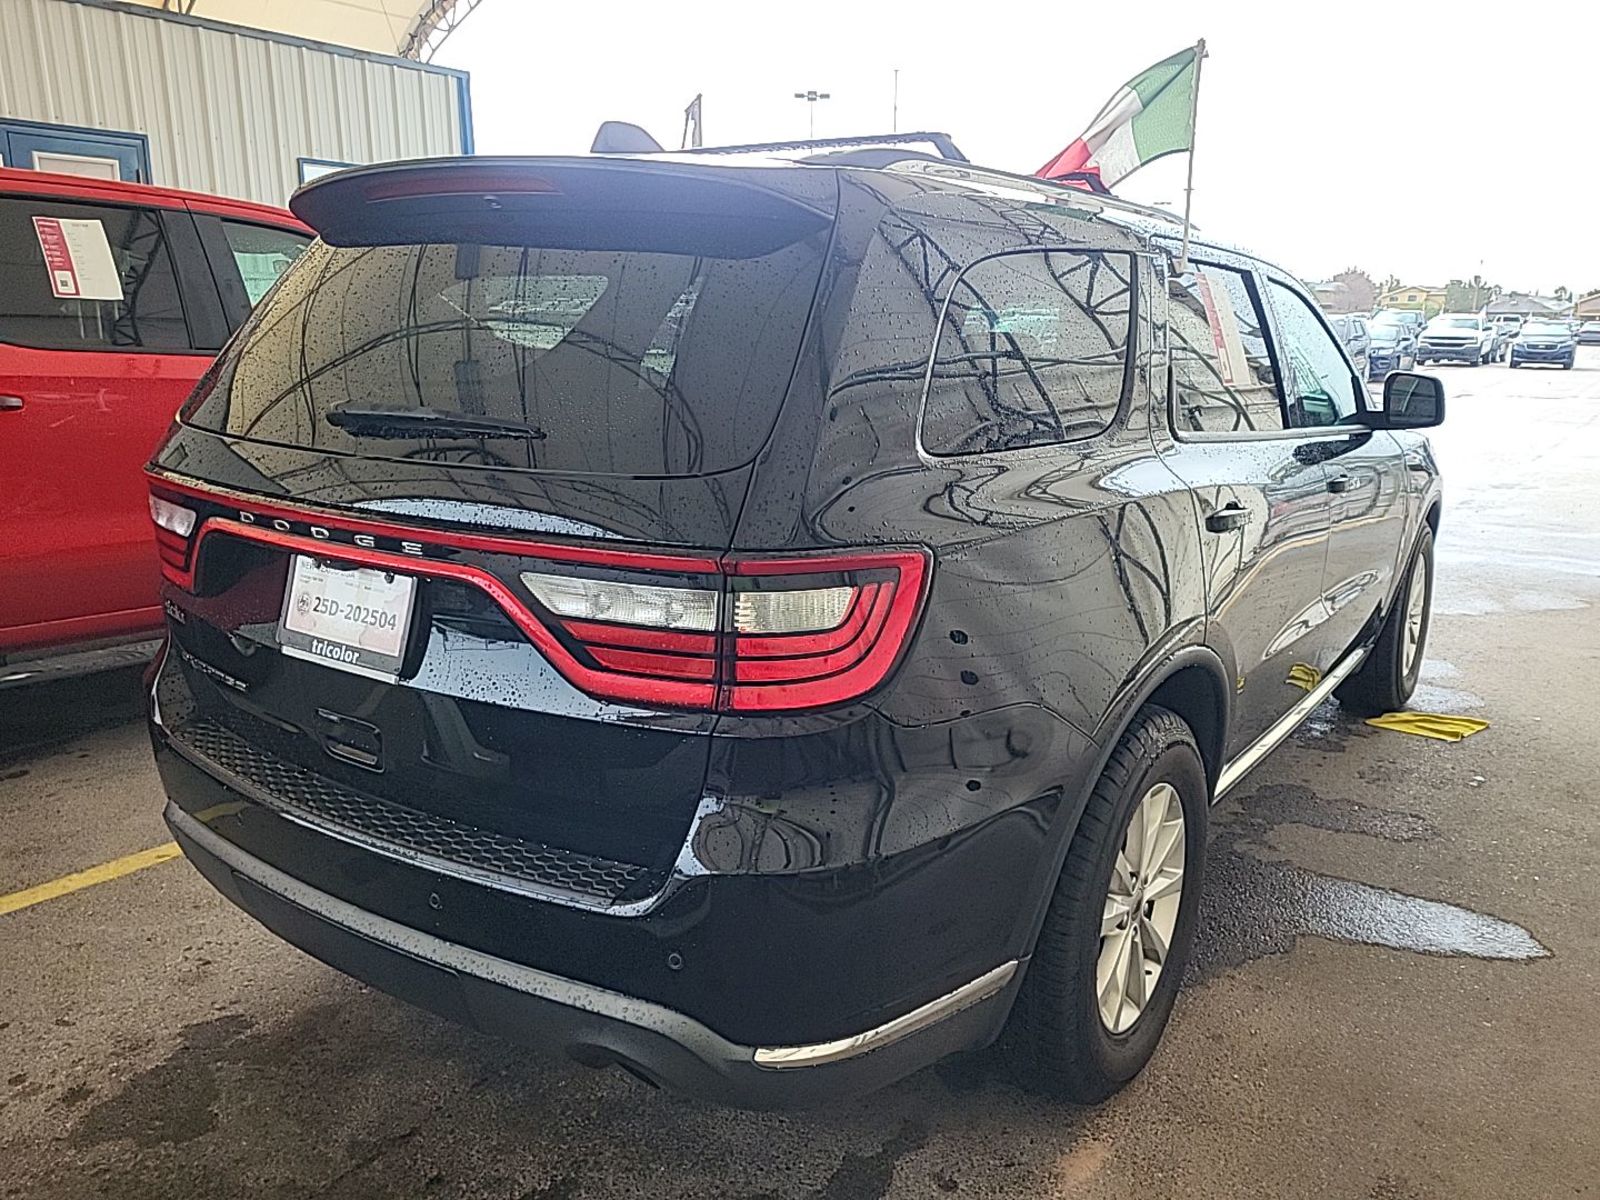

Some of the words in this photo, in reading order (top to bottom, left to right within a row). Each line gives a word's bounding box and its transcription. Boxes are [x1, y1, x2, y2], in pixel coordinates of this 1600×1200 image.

[239, 510, 423, 556] DODGE
[312, 596, 398, 631] 25D-202504
[311, 639, 360, 664] tricolor
